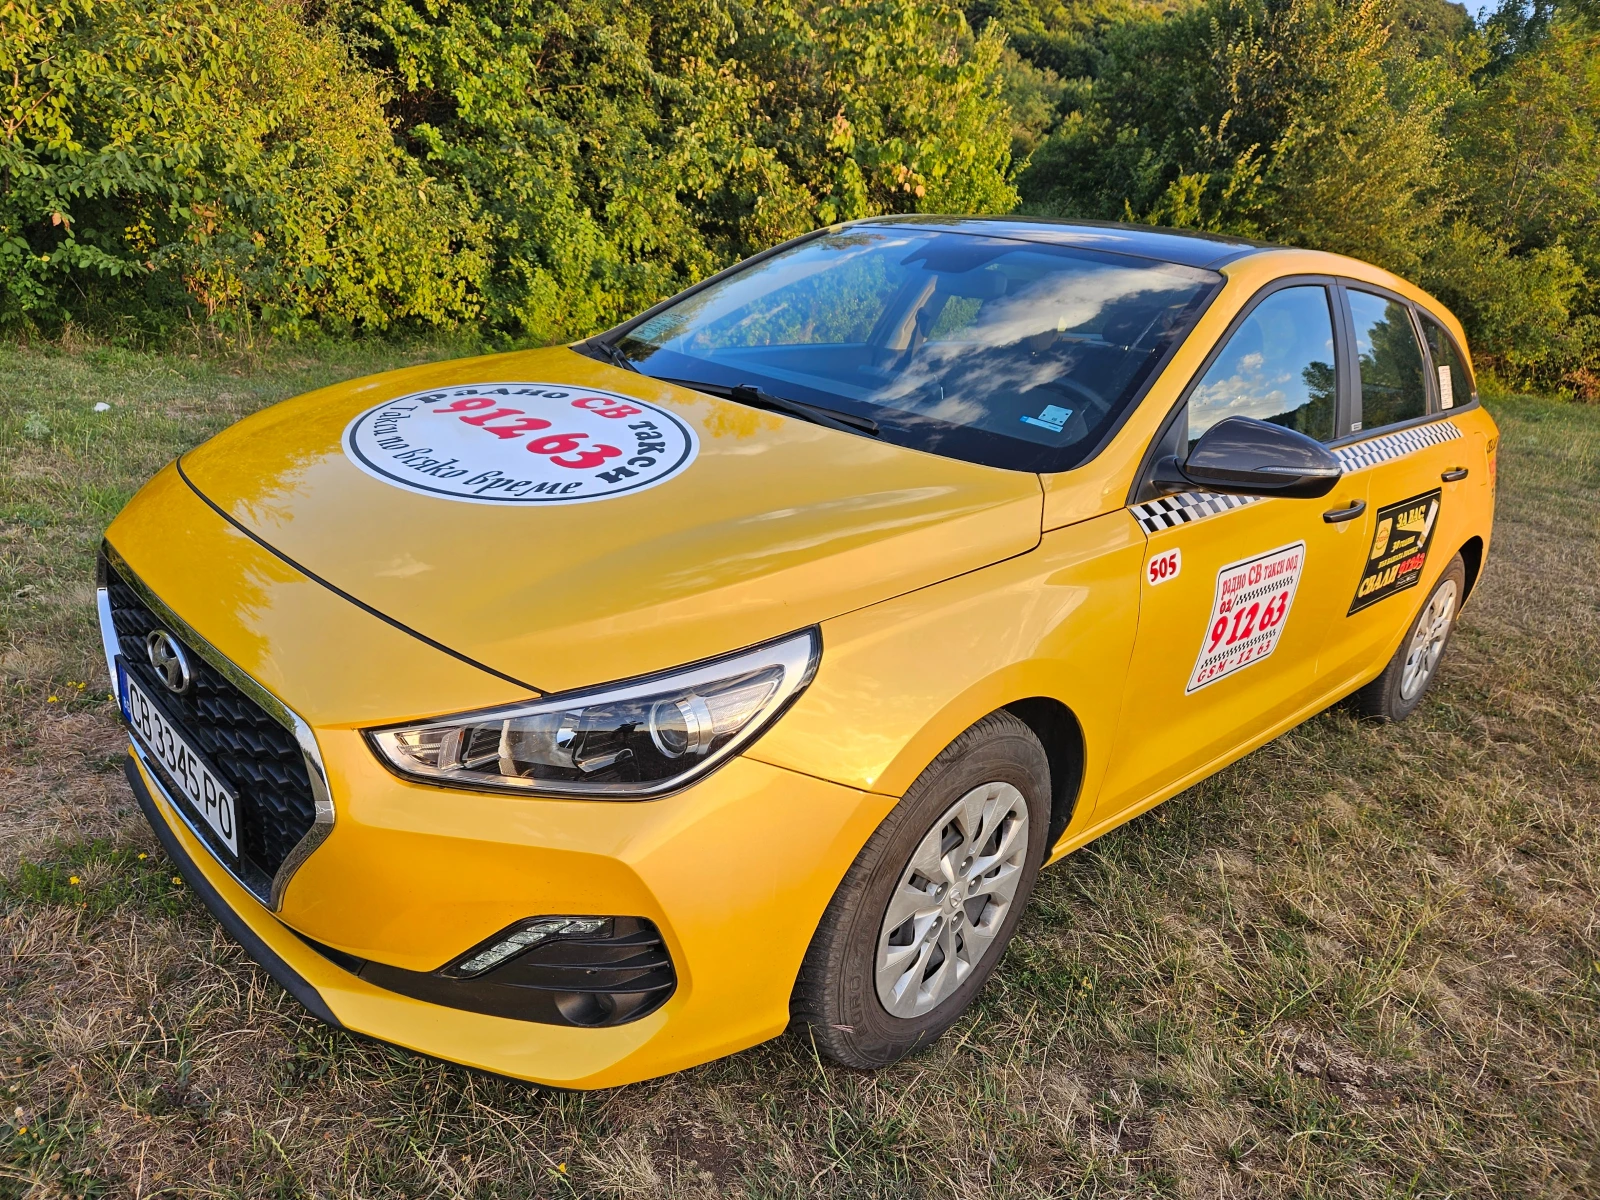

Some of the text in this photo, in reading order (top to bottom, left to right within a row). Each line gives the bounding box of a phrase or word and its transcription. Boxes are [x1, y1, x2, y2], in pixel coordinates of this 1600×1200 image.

[570, 397, 643, 419] СВ
[376, 435, 410, 451] по
[595, 420, 666, 484] такси
[392, 447, 469, 479] всяко
[462, 470, 583, 497] време
[1150, 553, 1177, 583] 505
[1247, 563, 1263, 586] СВ
[1263, 562, 1286, 581] такси
[154, 712, 201, 802] 3345
